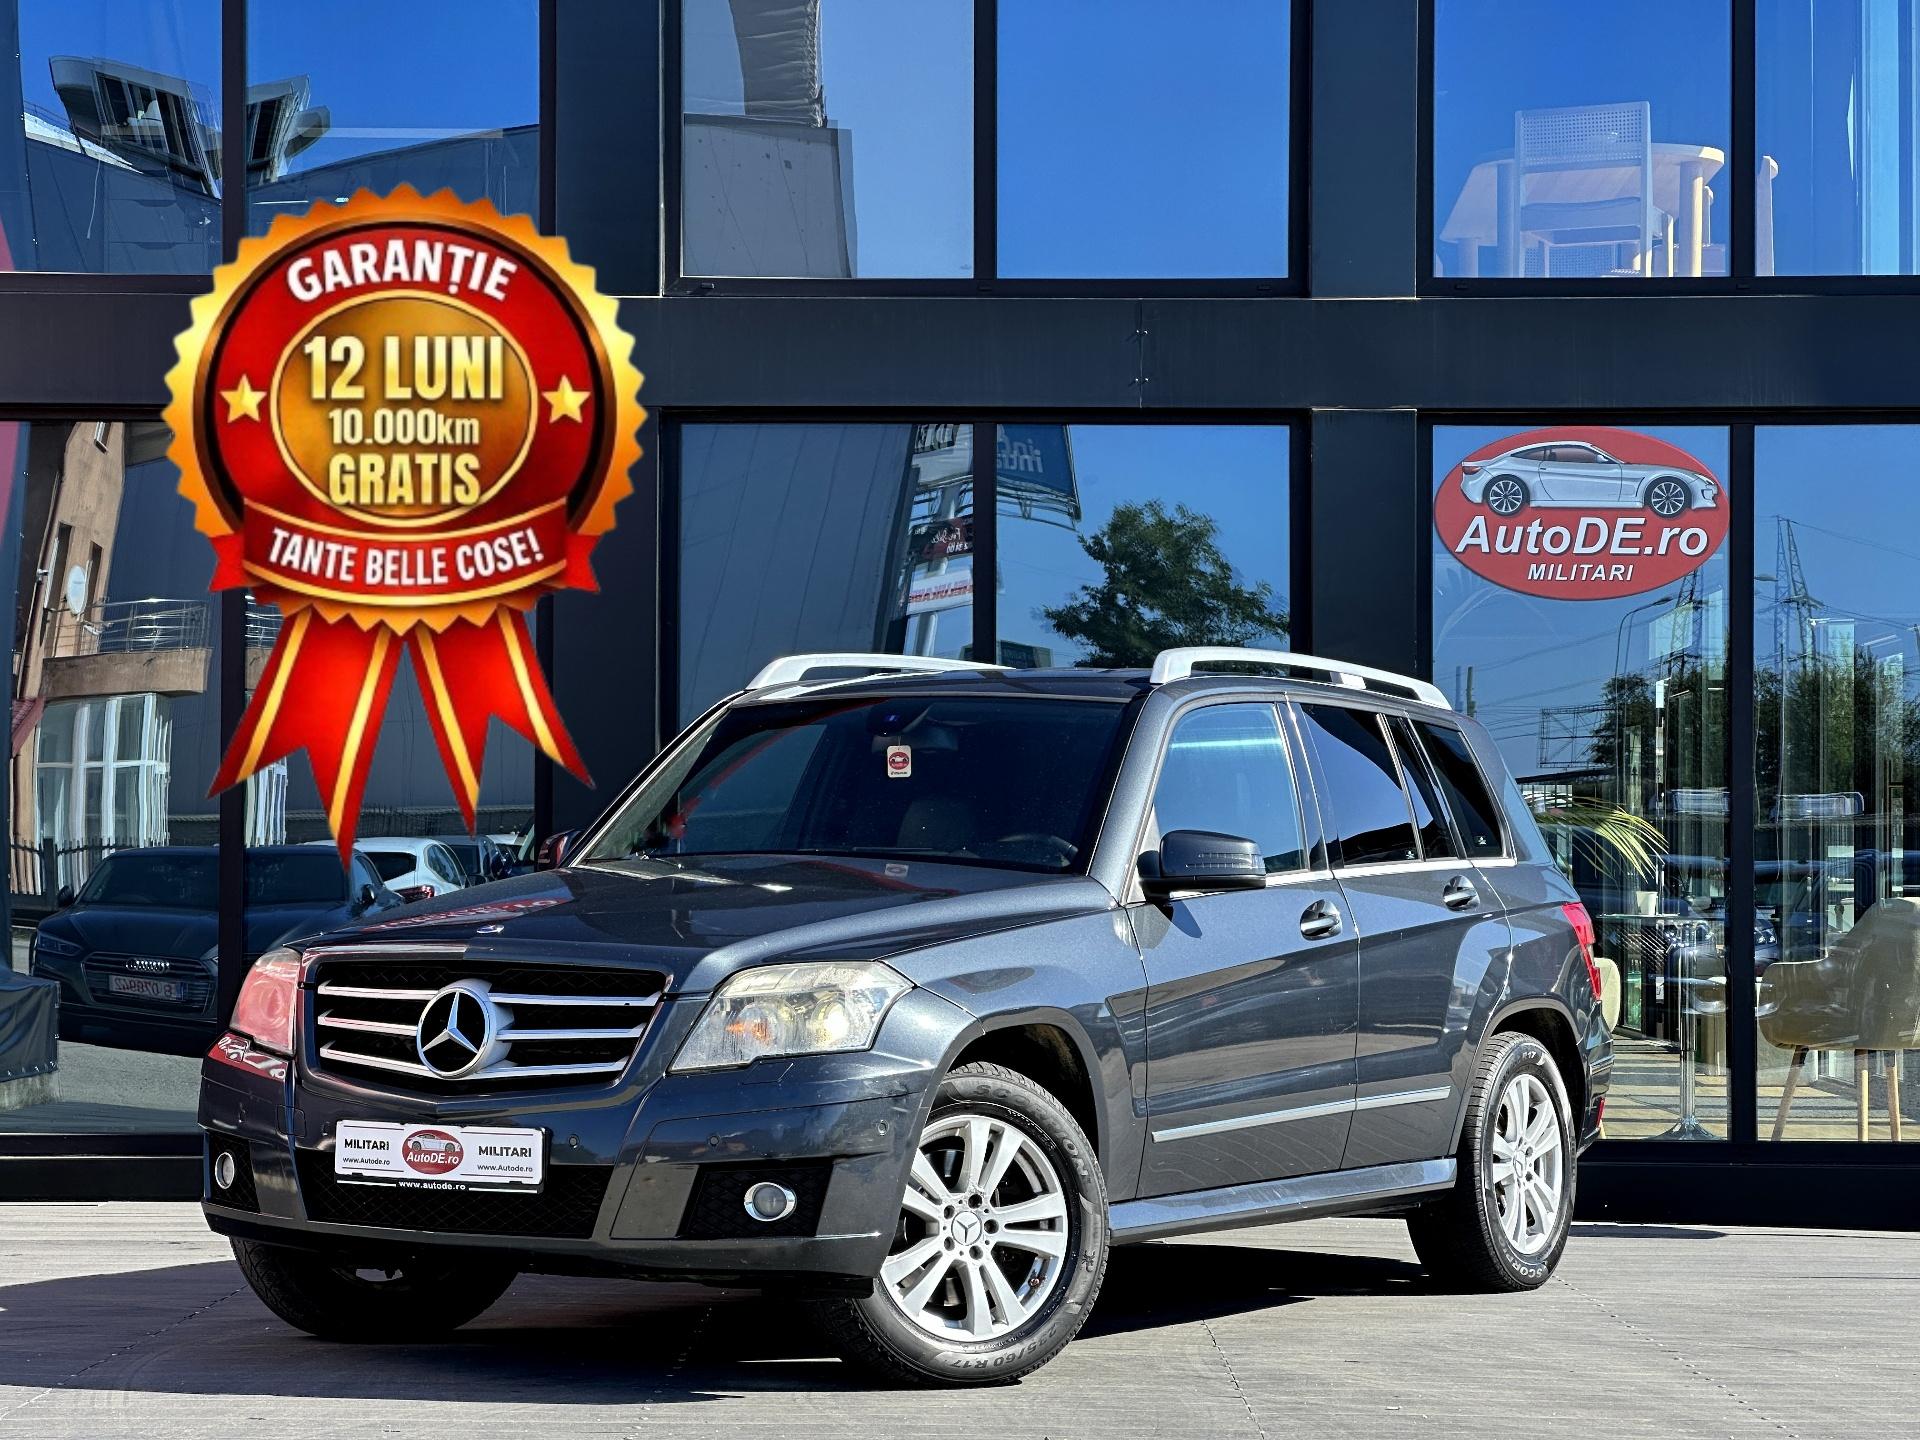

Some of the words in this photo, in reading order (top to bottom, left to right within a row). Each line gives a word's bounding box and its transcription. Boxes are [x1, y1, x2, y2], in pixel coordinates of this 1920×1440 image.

[1454, 515, 1708, 556] AutoDE.ro
[1527, 563, 1634, 581] MILITARI
[344, 1138, 390, 1151] MILITARI
[406, 1151, 459, 1166] AutoDE.ro
[478, 1146, 532, 1158] MILITARI
[477, 1164, 534, 1173] www.Autode.ro
[398, 1180, 466, 1191] www.autode.ro
